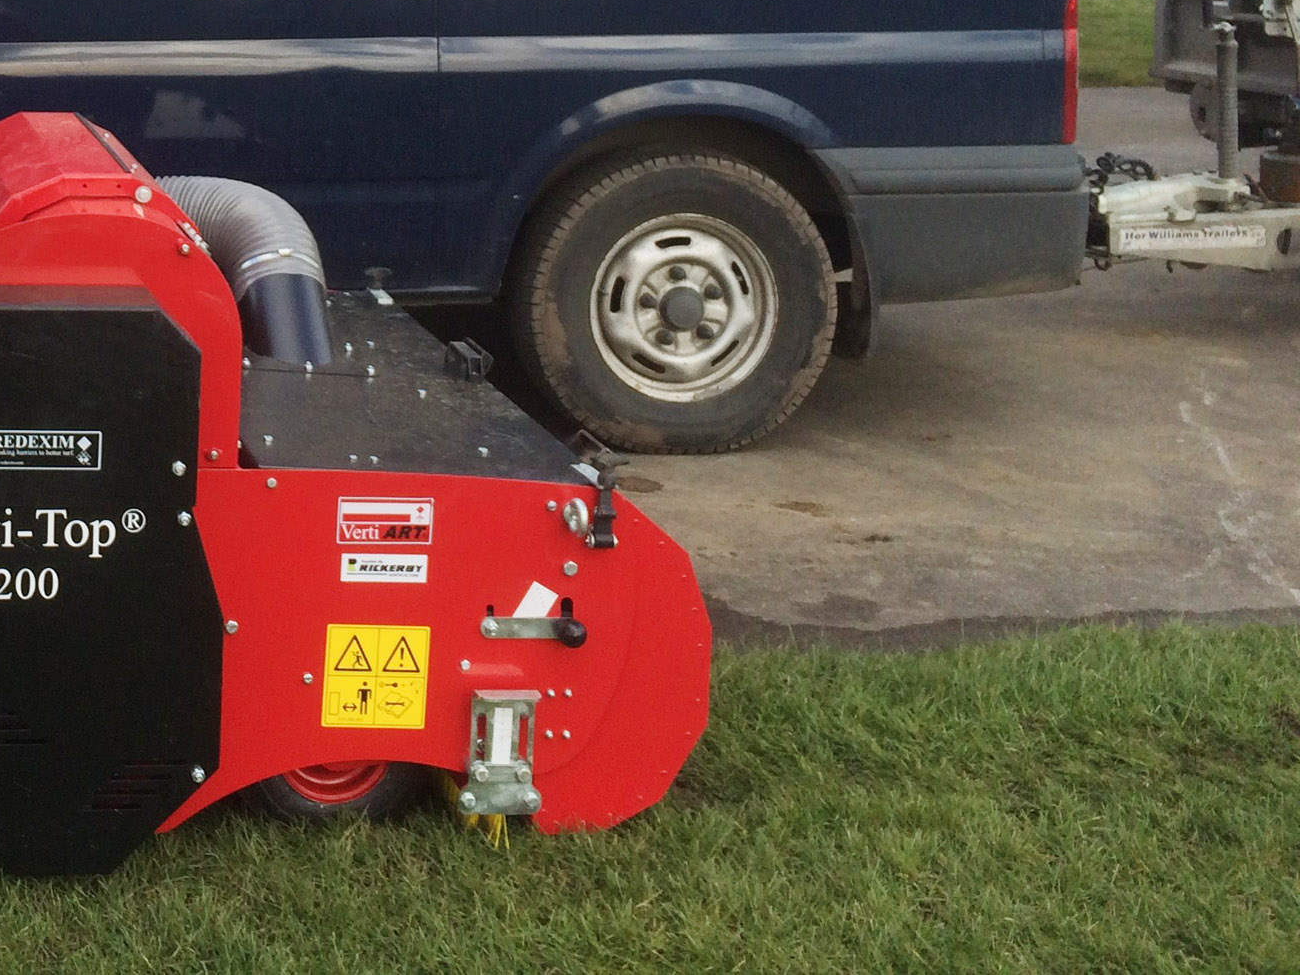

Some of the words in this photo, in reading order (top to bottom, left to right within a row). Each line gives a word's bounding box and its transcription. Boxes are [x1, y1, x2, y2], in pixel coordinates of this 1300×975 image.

[1149, 230, 1199, 239] Williams
[341, 524, 380, 540] Verti
[383, 525, 426, 539] ART
[359, 564, 423, 572] RICKERBY
